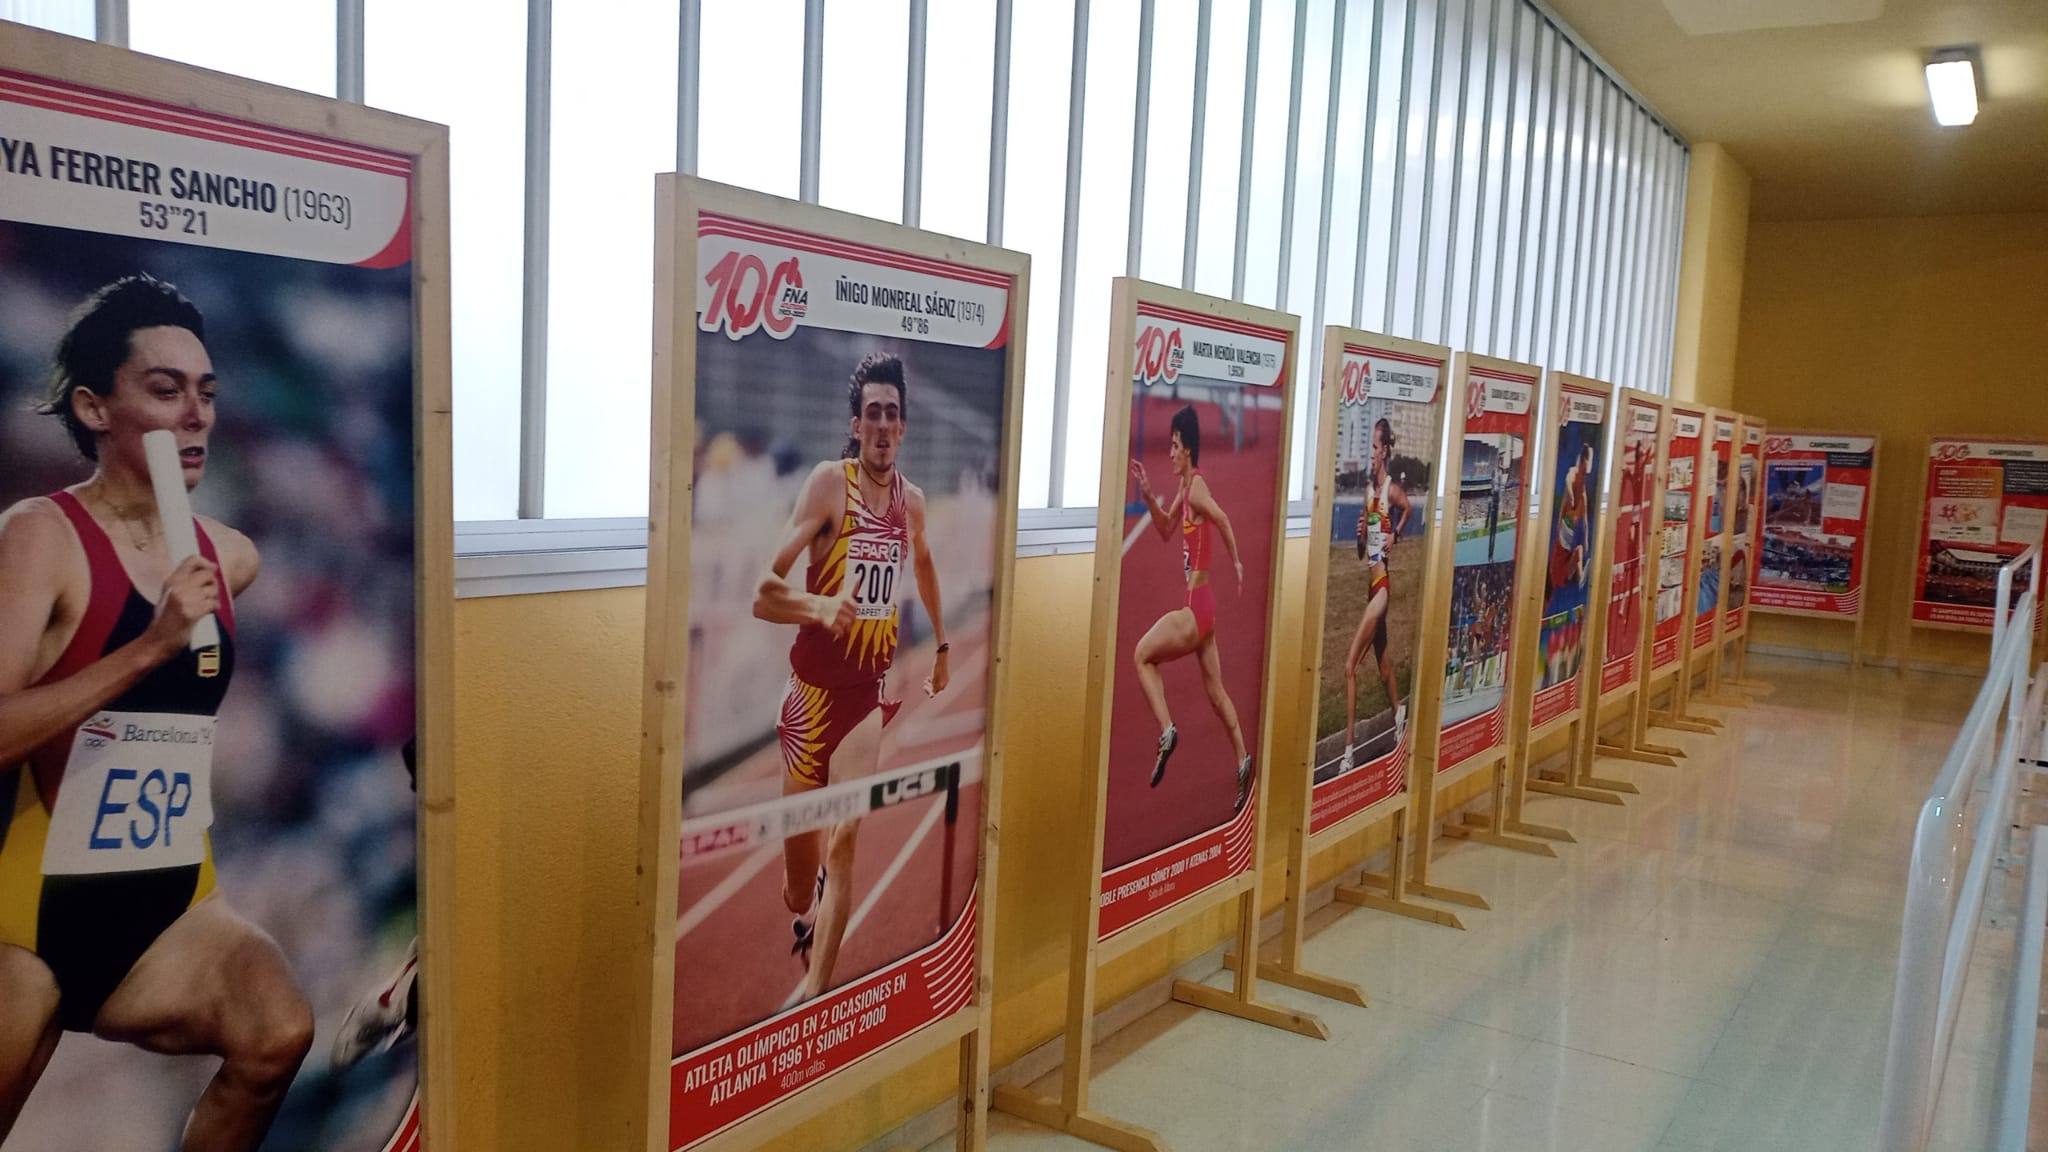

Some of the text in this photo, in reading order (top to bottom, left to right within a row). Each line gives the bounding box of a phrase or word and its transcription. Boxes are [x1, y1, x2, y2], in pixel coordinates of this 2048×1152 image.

[0, 136, 351, 229] YA FERRER SANCHO (1963)
[782, 287, 809, 305] FNA
[835, 275, 985, 326] IÑIGO MONREAL SÁENZ (1974)
[1193, 341, 1213, 359] MARTA
[848, 541, 888, 560] SPAR
[853, 563, 894, 605] 200
[122, 723, 197, 745] Barcelona
[89, 768, 192, 850] ESP
[1117, 875, 1150, 900] PRESENCIA
[1171, 860, 1185, 877] 2000
[1189, 850, 1209, 868] ATENAS
[684, 972, 907, 1094] ATLETA OLÍMPICO EN 2 OCASIONES EN
[710, 1004, 887, 1107] ATLANTA 1996 Y SIDNEY 2000
[780, 1058, 826, 1090] 400m vallas
